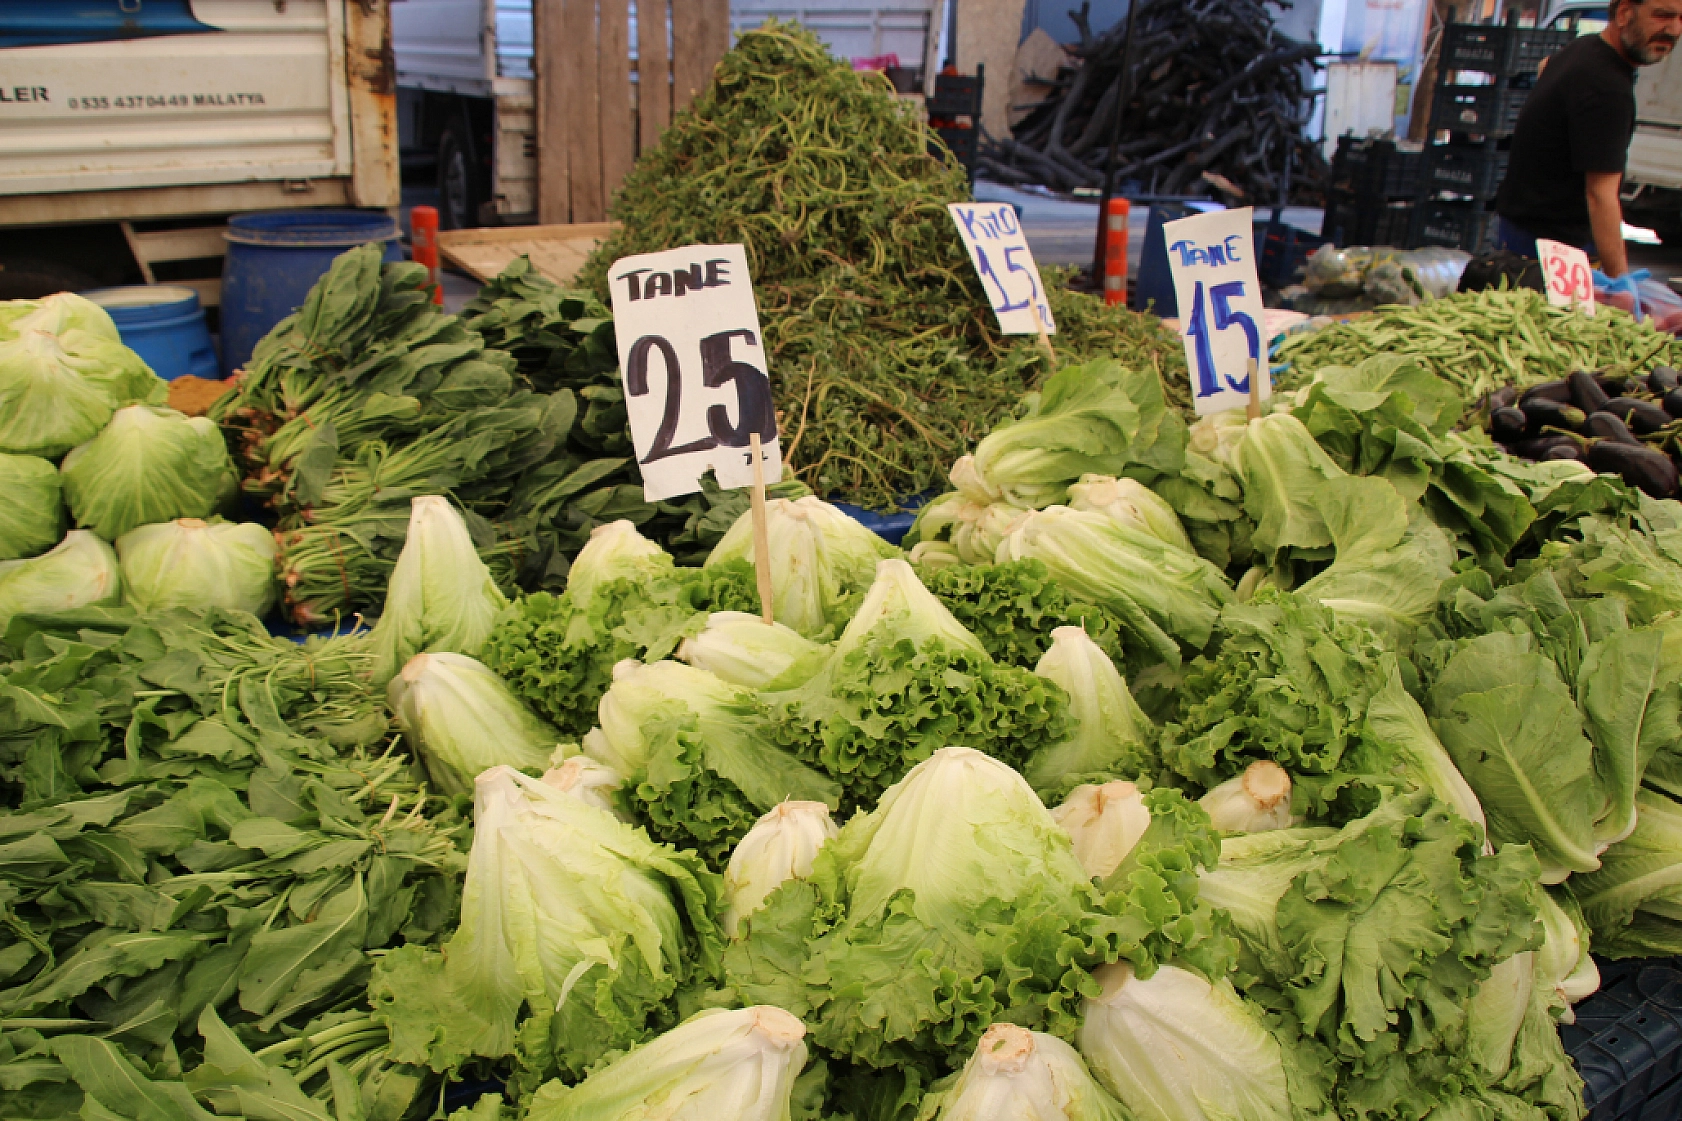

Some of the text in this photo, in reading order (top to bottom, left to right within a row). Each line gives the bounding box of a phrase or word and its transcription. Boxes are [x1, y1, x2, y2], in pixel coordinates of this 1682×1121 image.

[192, 92, 265, 106] MALATYA
[975, 245, 1037, 312] 15
[1170, 235, 1243, 267] TANE
[616, 258, 731, 302] TANE
[1187, 280, 1260, 397] 15
[627, 327, 778, 464] 25
